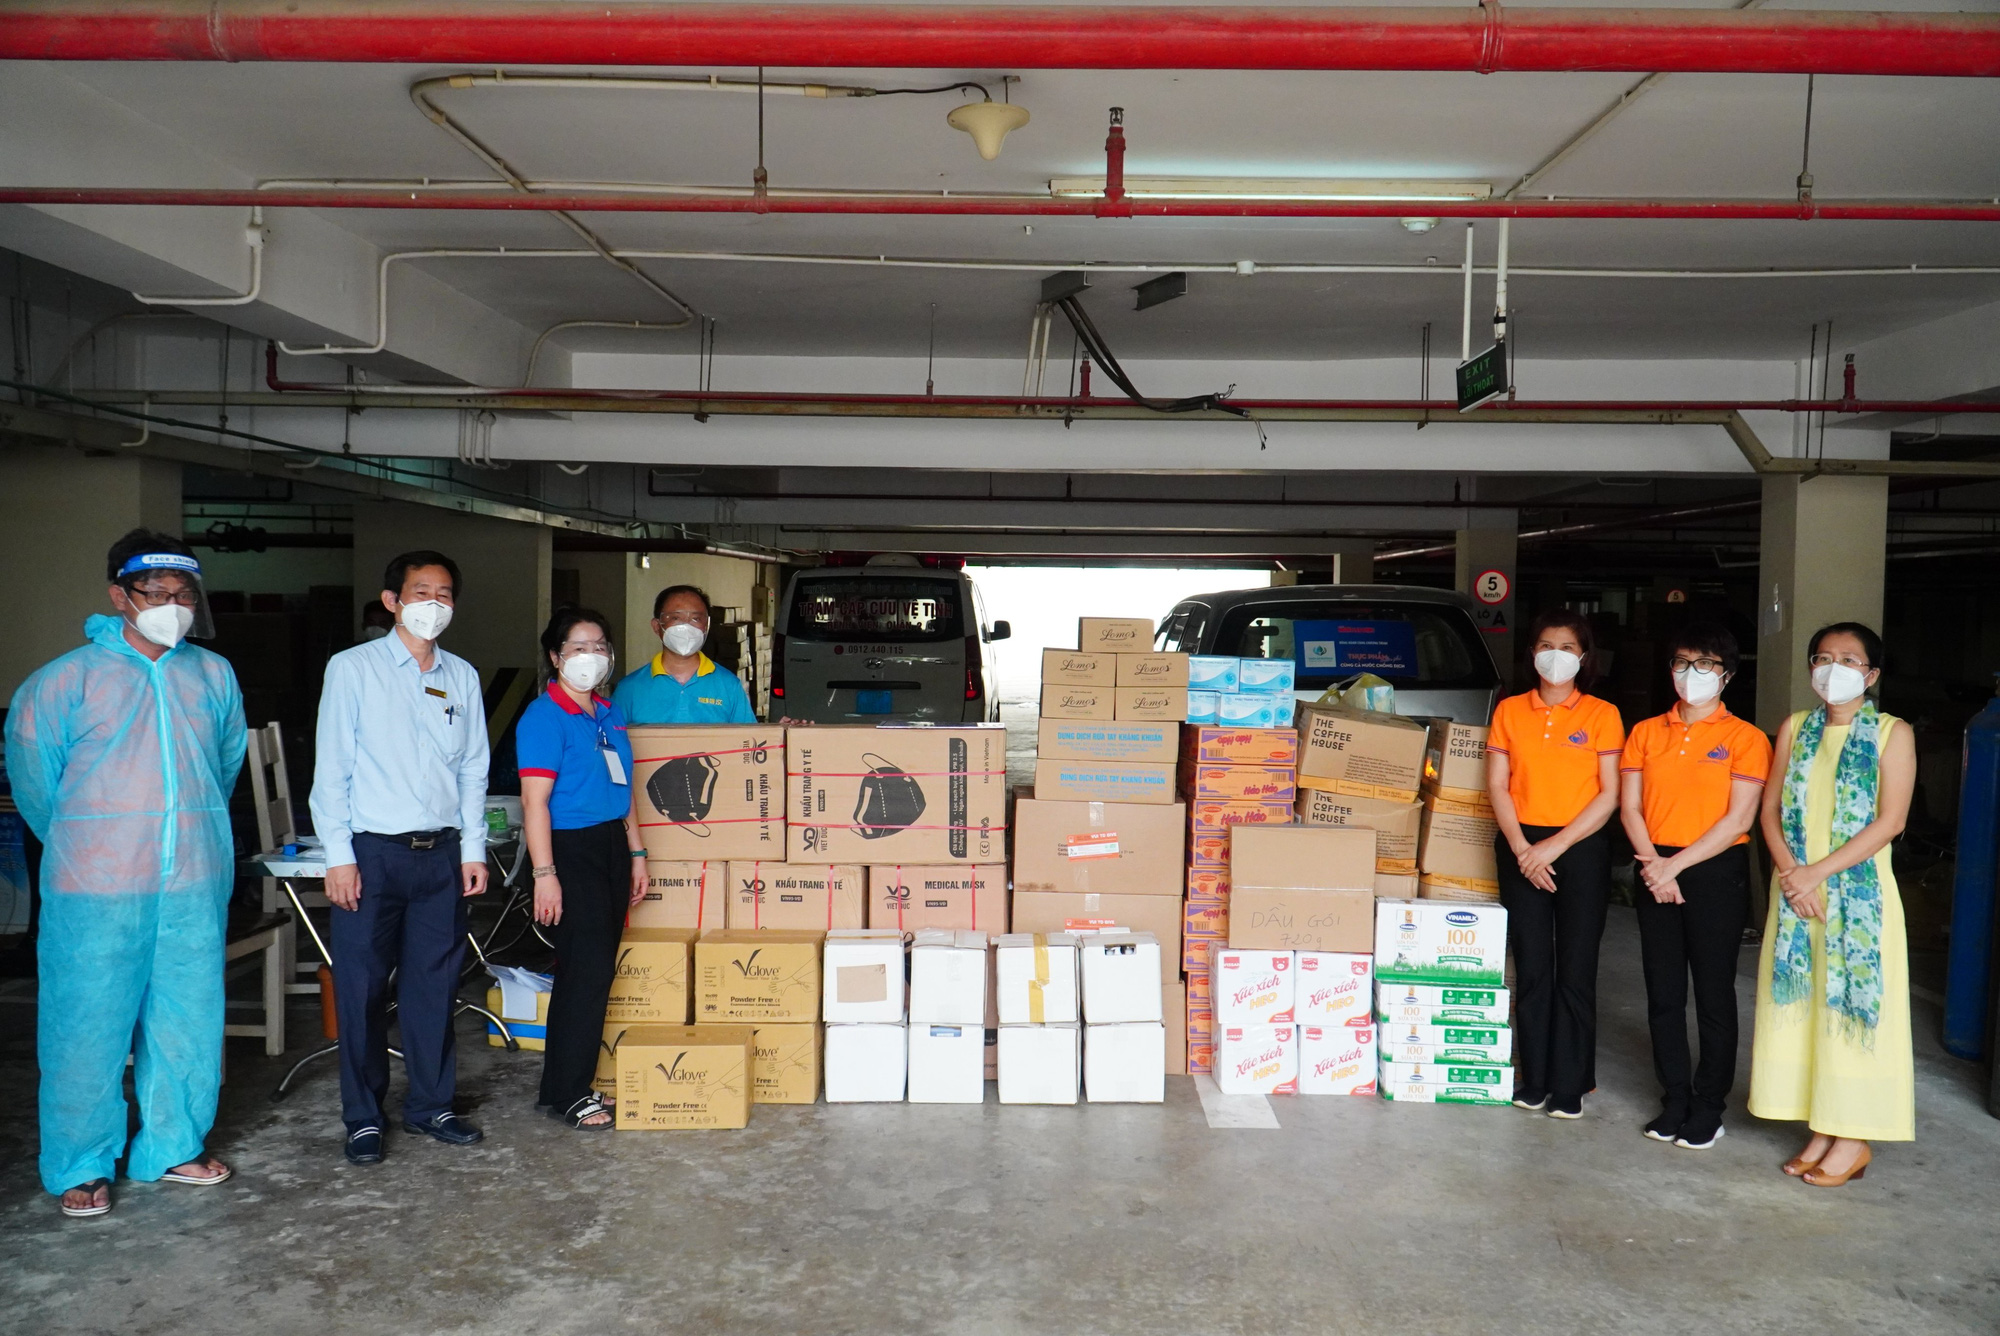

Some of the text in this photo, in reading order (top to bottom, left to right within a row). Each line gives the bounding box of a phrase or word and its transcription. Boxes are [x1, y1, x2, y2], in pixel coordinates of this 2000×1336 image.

[1466, 358, 1490, 379] EXIT
[1488, 576, 1497, 591] 5
[1492, 611, 1506, 626] A
[848, 645, 904, 654] 0912.440.115
[1316, 718, 1335, 729] THE
[1313, 729, 1353, 742] COFFEE
[1453, 728, 1471, 738] THE
[1311, 738, 1345, 751] HOUSE
[800, 748, 812, 758] TẾ
[1450, 748, 1484, 760] HOUSE
[760, 774, 771, 795] KHẨU
[1244, 783, 1279, 796] Hảo Hảo
[800, 796, 812, 817] KHẨU
[1314, 803, 1353, 816] COFFEE
[1244, 808, 1267, 823] Hảo
[1312, 813, 1346, 825] HOUSE
[761, 832, 771, 842] TẾ
[658, 879, 684, 887] TRANG
[687, 879, 692, 887] Y
[776, 876, 825, 890] KHẨU TRANG
[925, 880, 960, 890] MEDICAL
[1447, 929, 1476, 946] 100
[1257, 974, 1281, 992] xích
[1334, 978, 1359, 995] xích
[1404, 1007, 1420, 1016] 100
[1260, 1045, 1284, 1063] xích
[1338, 1047, 1363, 1065] xích
[1407, 1046, 1423, 1055] 100
[1408, 1085, 1424, 1094] 100
